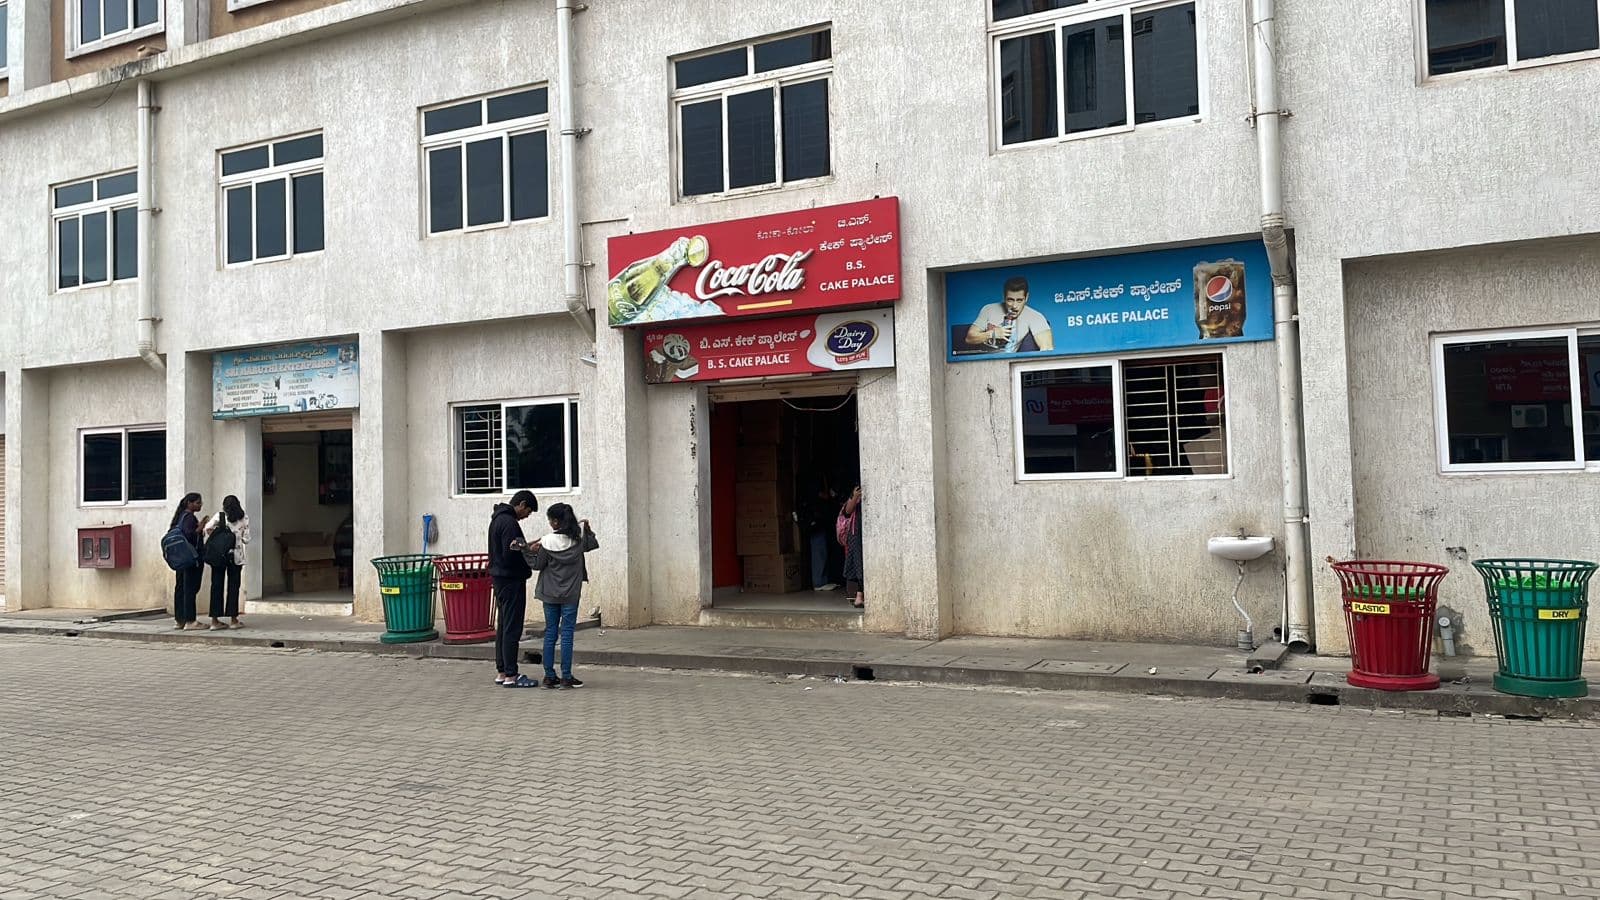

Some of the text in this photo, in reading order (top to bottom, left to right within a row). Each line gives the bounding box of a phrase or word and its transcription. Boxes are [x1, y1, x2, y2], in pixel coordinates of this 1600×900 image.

[819, 238, 845, 251] ಕೇಕ್
[819, 274, 895, 292] CAKE PALACE
[1208, 302, 1231, 313] pepsi
[1067, 308, 1169, 327] BS CAKE PALACE
[833, 326, 867, 341] Dairy
[837, 337, 863, 352] Day
[707, 353, 790, 369] B. S. CAKE PALACE
[1354, 603, 1386, 613] PLASTIC
[1552, 610, 1569, 619] DRY
